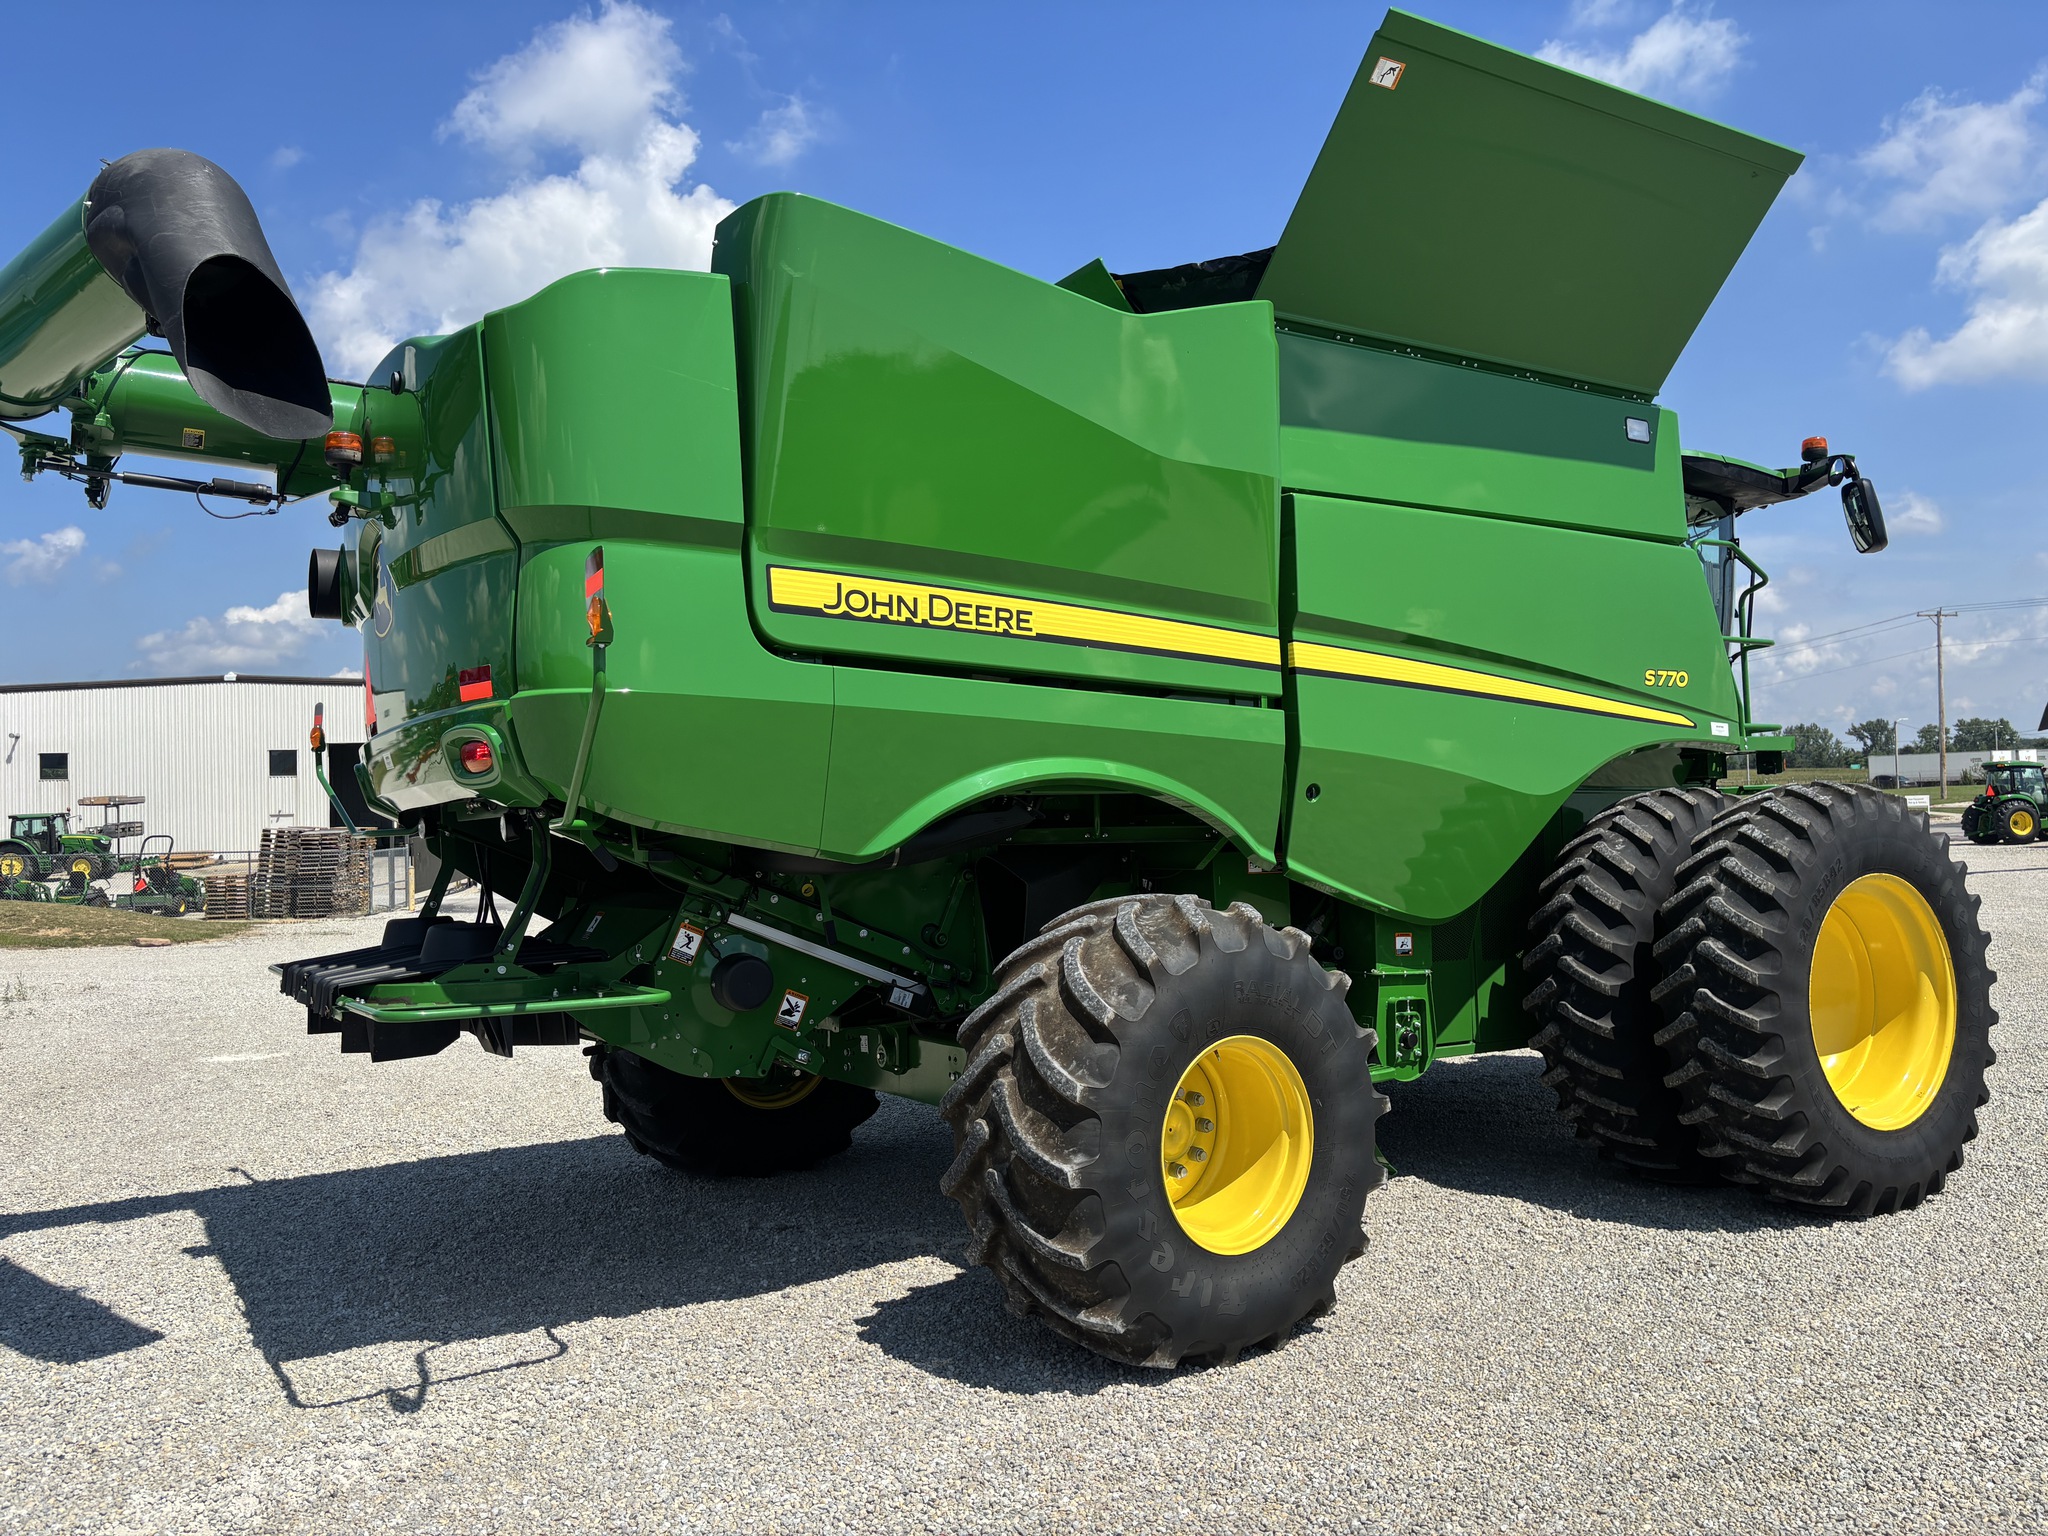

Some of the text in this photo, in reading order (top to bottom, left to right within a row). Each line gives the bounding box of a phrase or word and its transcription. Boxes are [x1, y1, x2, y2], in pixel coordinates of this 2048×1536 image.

[823, 582, 1033, 632] JOHN DEERE
[1644, 669, 1689, 688] S770
